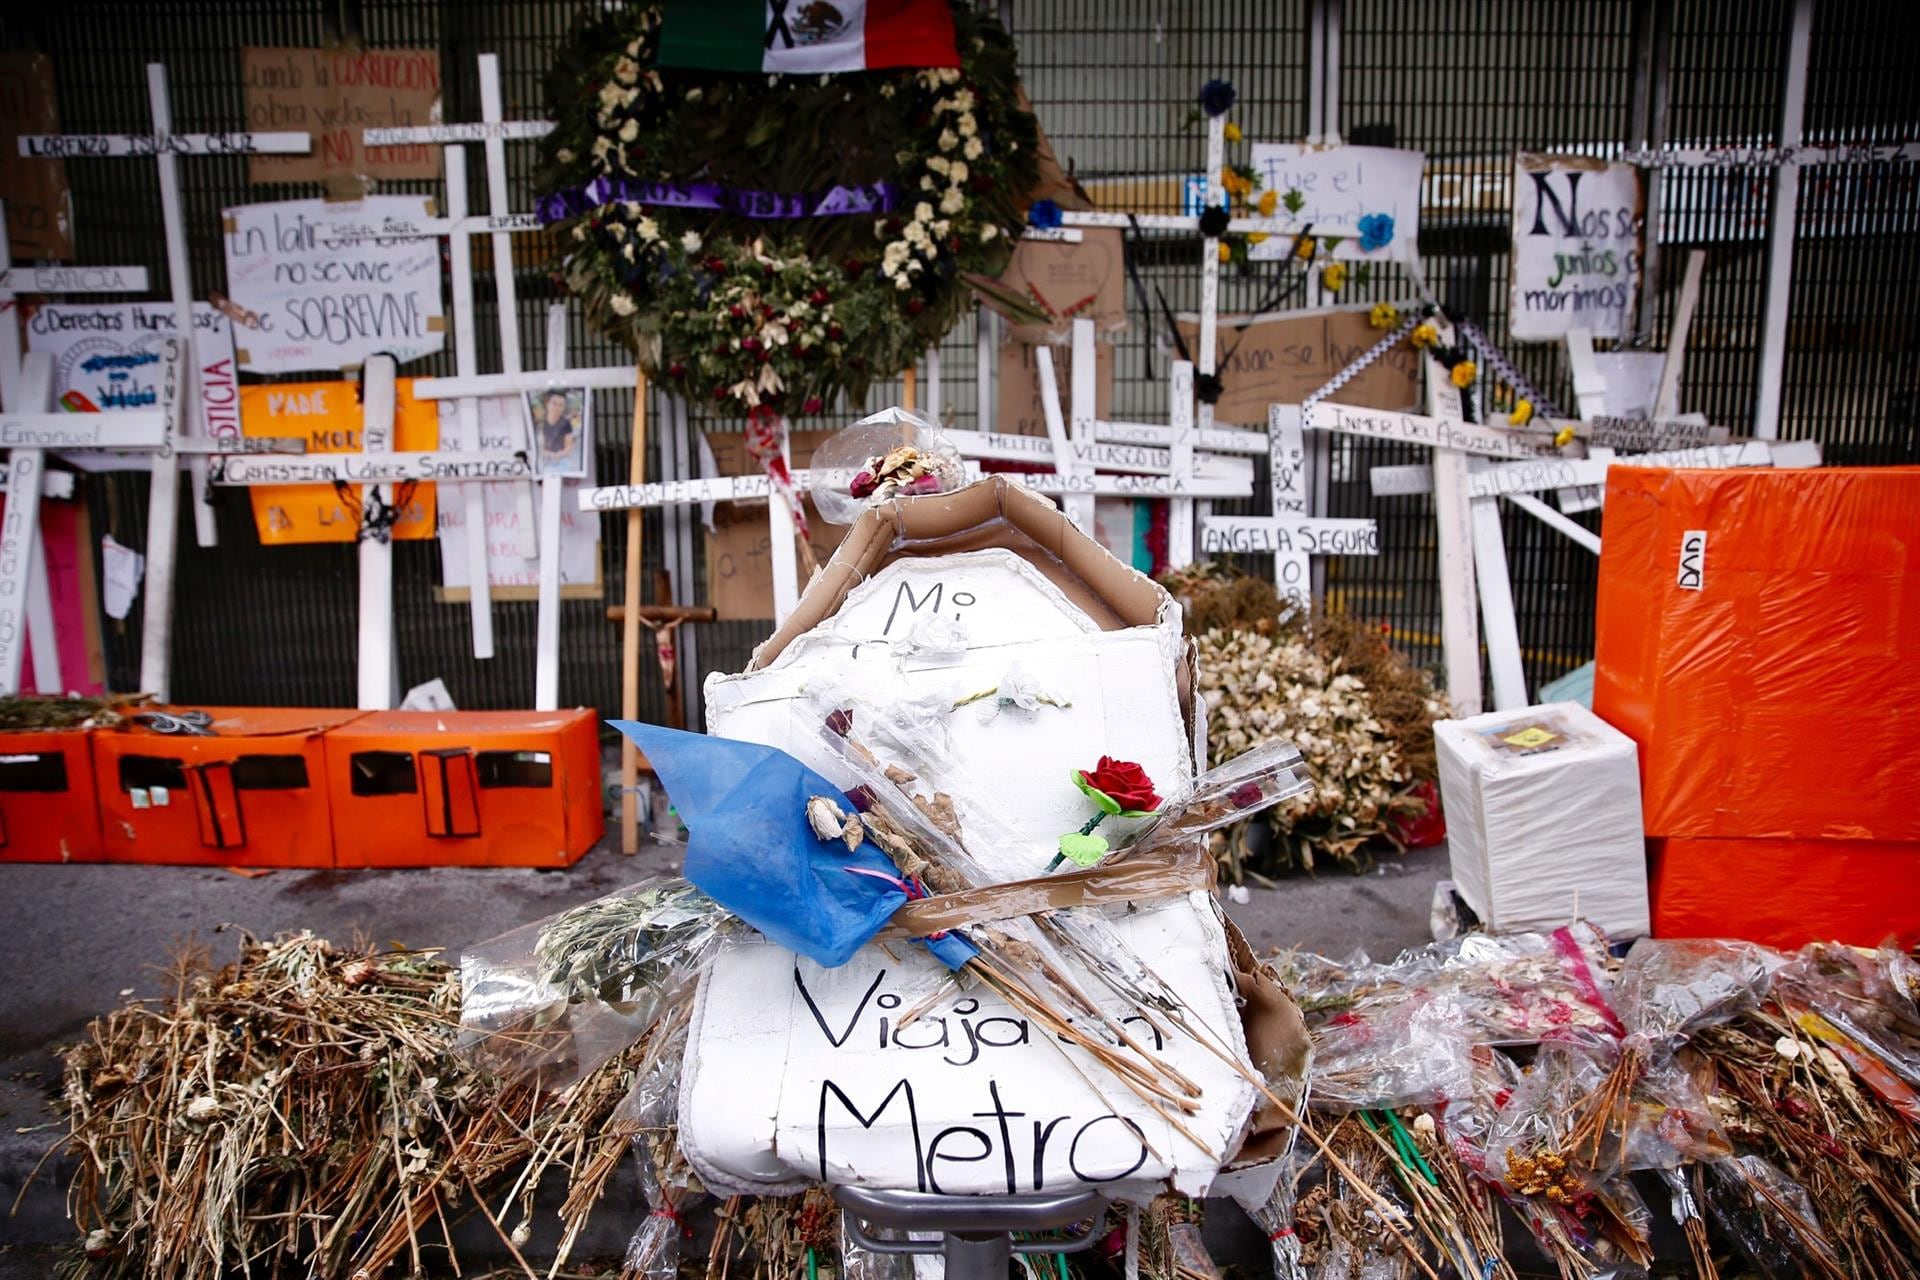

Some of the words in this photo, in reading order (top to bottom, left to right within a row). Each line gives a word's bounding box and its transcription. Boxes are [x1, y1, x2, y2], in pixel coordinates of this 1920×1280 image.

[28, 136, 110, 155] LORENZO
[205, 134, 259, 154] CRUZ
[322, 130, 354, 168] NO
[1705, 148, 1796, 167] SALAZAR
[1263, 157, 1319, 192] Fue
[1332, 161, 1362, 192] el
[1528, 171, 1610, 239] Nos
[275, 261, 306, 284] no
[1548, 240, 1617, 288] juntos
[1524, 282, 1627, 312] morimos
[32, 307, 124, 335] ¿Derechos
[132, 307, 224, 334] Humaos?
[285, 291, 424, 346] SOBREVIVE
[1592, 415, 1656, 435] BRANDON
[591, 479, 713, 509] GABRIELA
[1277, 498, 1305, 512] PAZ
[1206, 525, 1292, 552] ANGELA
[794, 967, 1029, 1066] Viaja
[818, 1078, 1148, 1195] Metro
